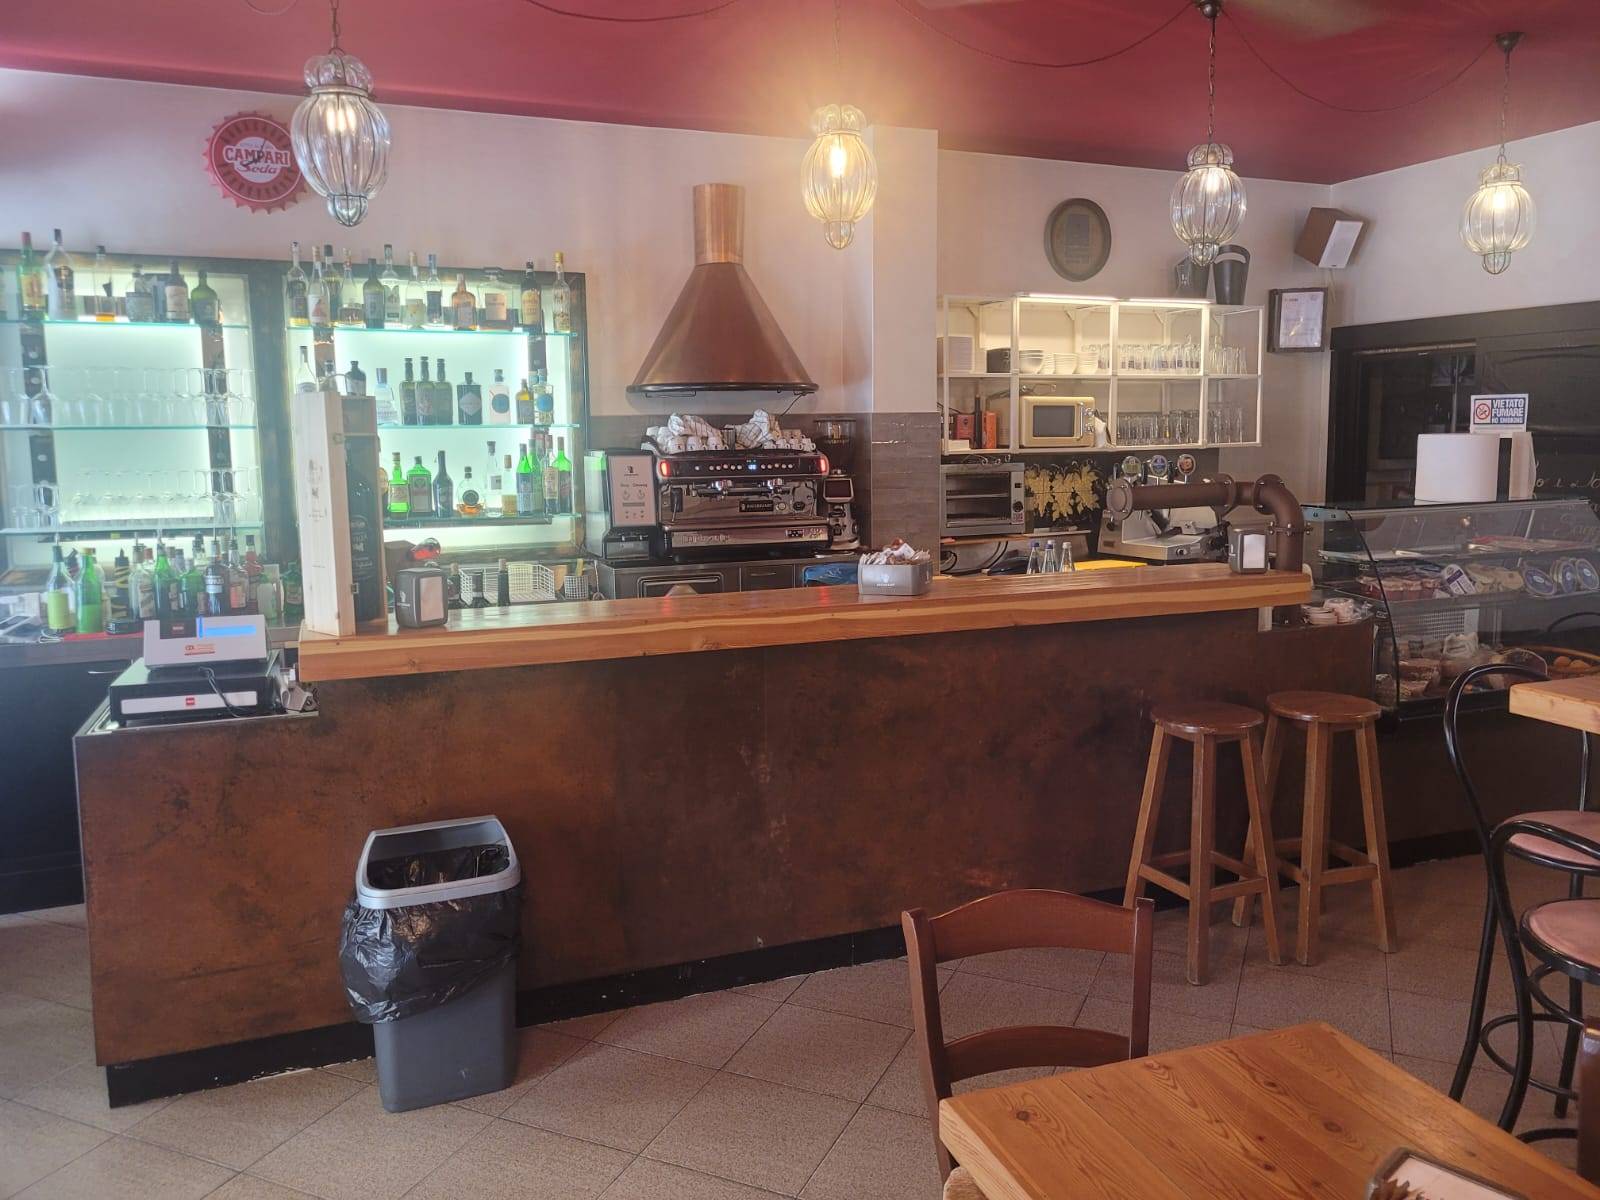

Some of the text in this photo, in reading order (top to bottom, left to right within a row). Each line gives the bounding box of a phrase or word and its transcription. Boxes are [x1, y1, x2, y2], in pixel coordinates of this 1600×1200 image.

[224, 147, 289, 165] CAMPARI
[237, 160, 278, 174] Soda
[1492, 399, 1524, 408] VIETATO
[1492, 408, 1524, 417] FUMARE
